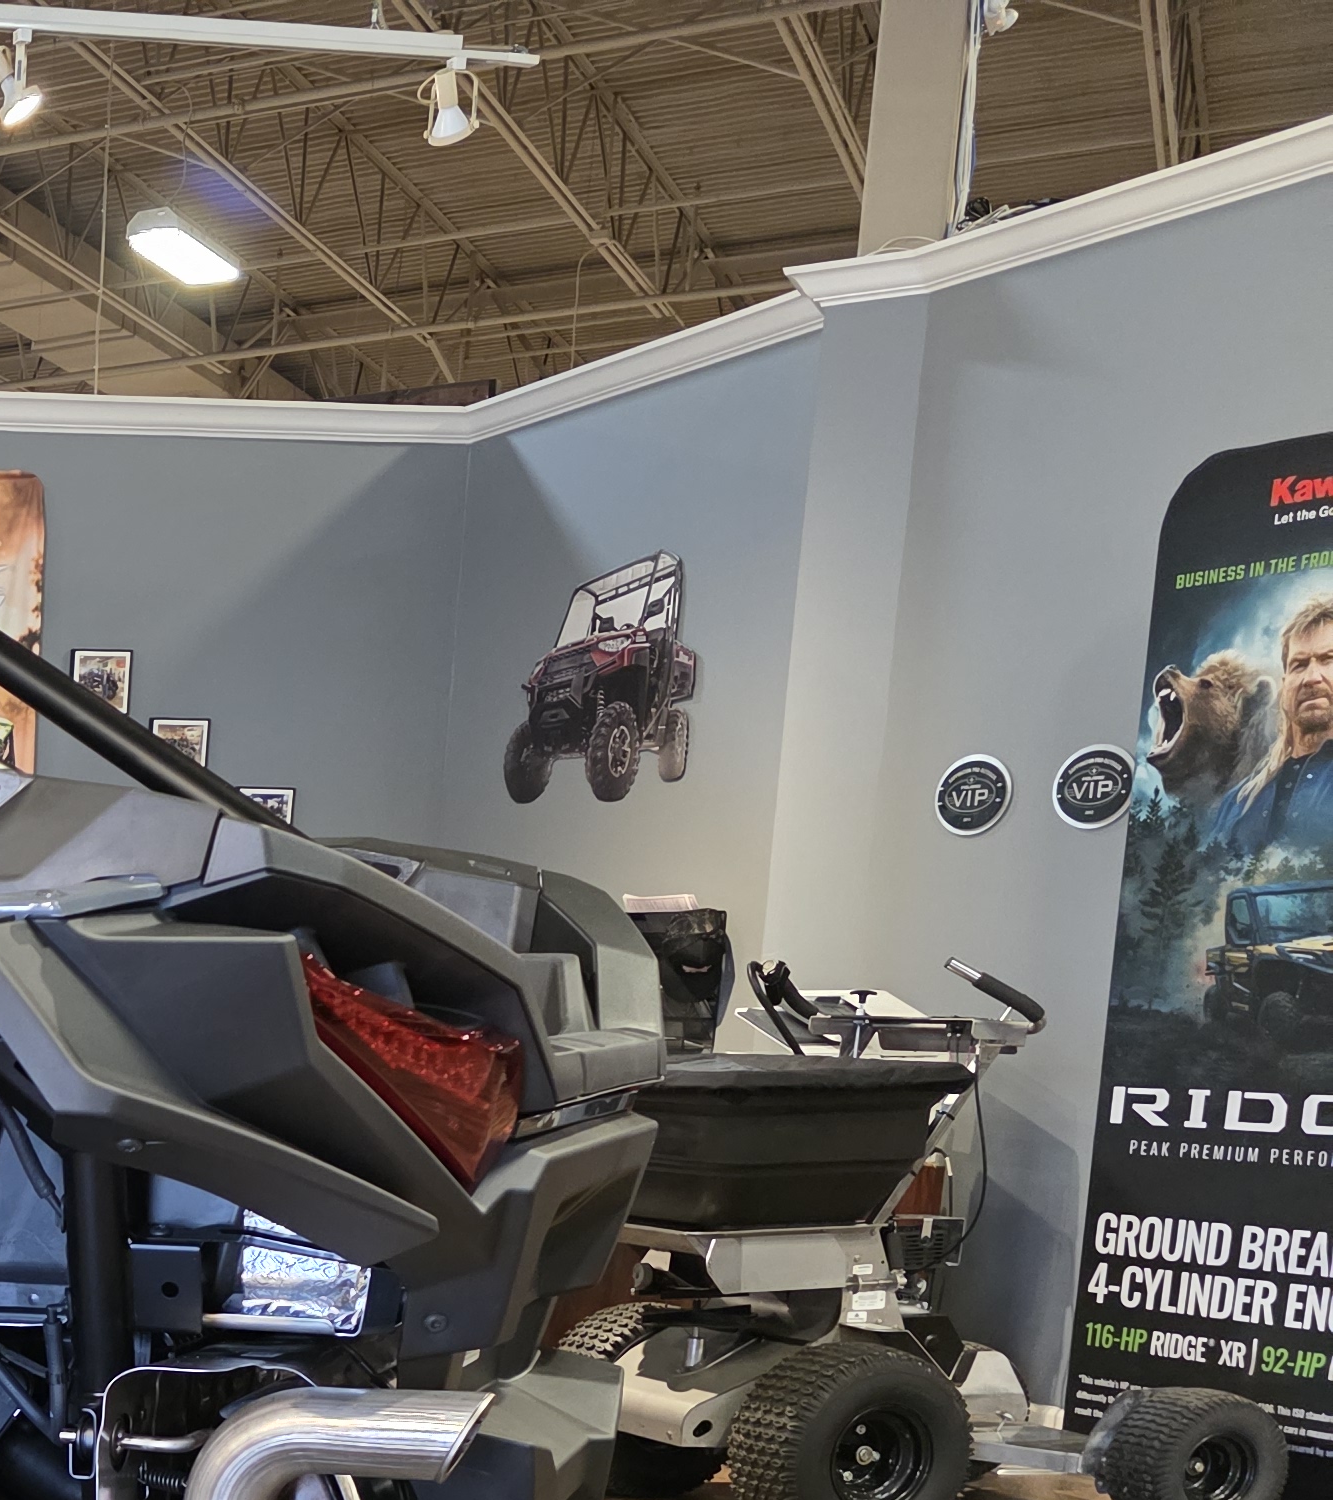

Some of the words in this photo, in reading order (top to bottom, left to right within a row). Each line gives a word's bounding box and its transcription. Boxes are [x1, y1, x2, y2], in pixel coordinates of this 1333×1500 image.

[1274, 512, 1293, 525] Let
[1296, 509, 1316, 521] the
[1175, 564, 1245, 590] BUSINESS
[1249, 561, 1264, 578] IN
[1269, 556, 1297, 574] THE
[951, 788, 989, 808] VIP
[1072, 780, 1113, 800] VIP
[1129, 1139, 1171, 1158] PEAK
[1179, 1142, 1260, 1163] PREMIUM
[1269, 1148, 1333, 1168] PERFO
[1094, 1211, 1232, 1267] GROUND
[1238, 1225, 1333, 1278] BREA
[1087, 1262, 1278, 1326] 4-CYLINDER
[1085, 1322, 1148, 1353] 116-HP
[1217, 1339, 1247, 1369] XR
[1260, 1345, 1327, 1378] 92-HP
